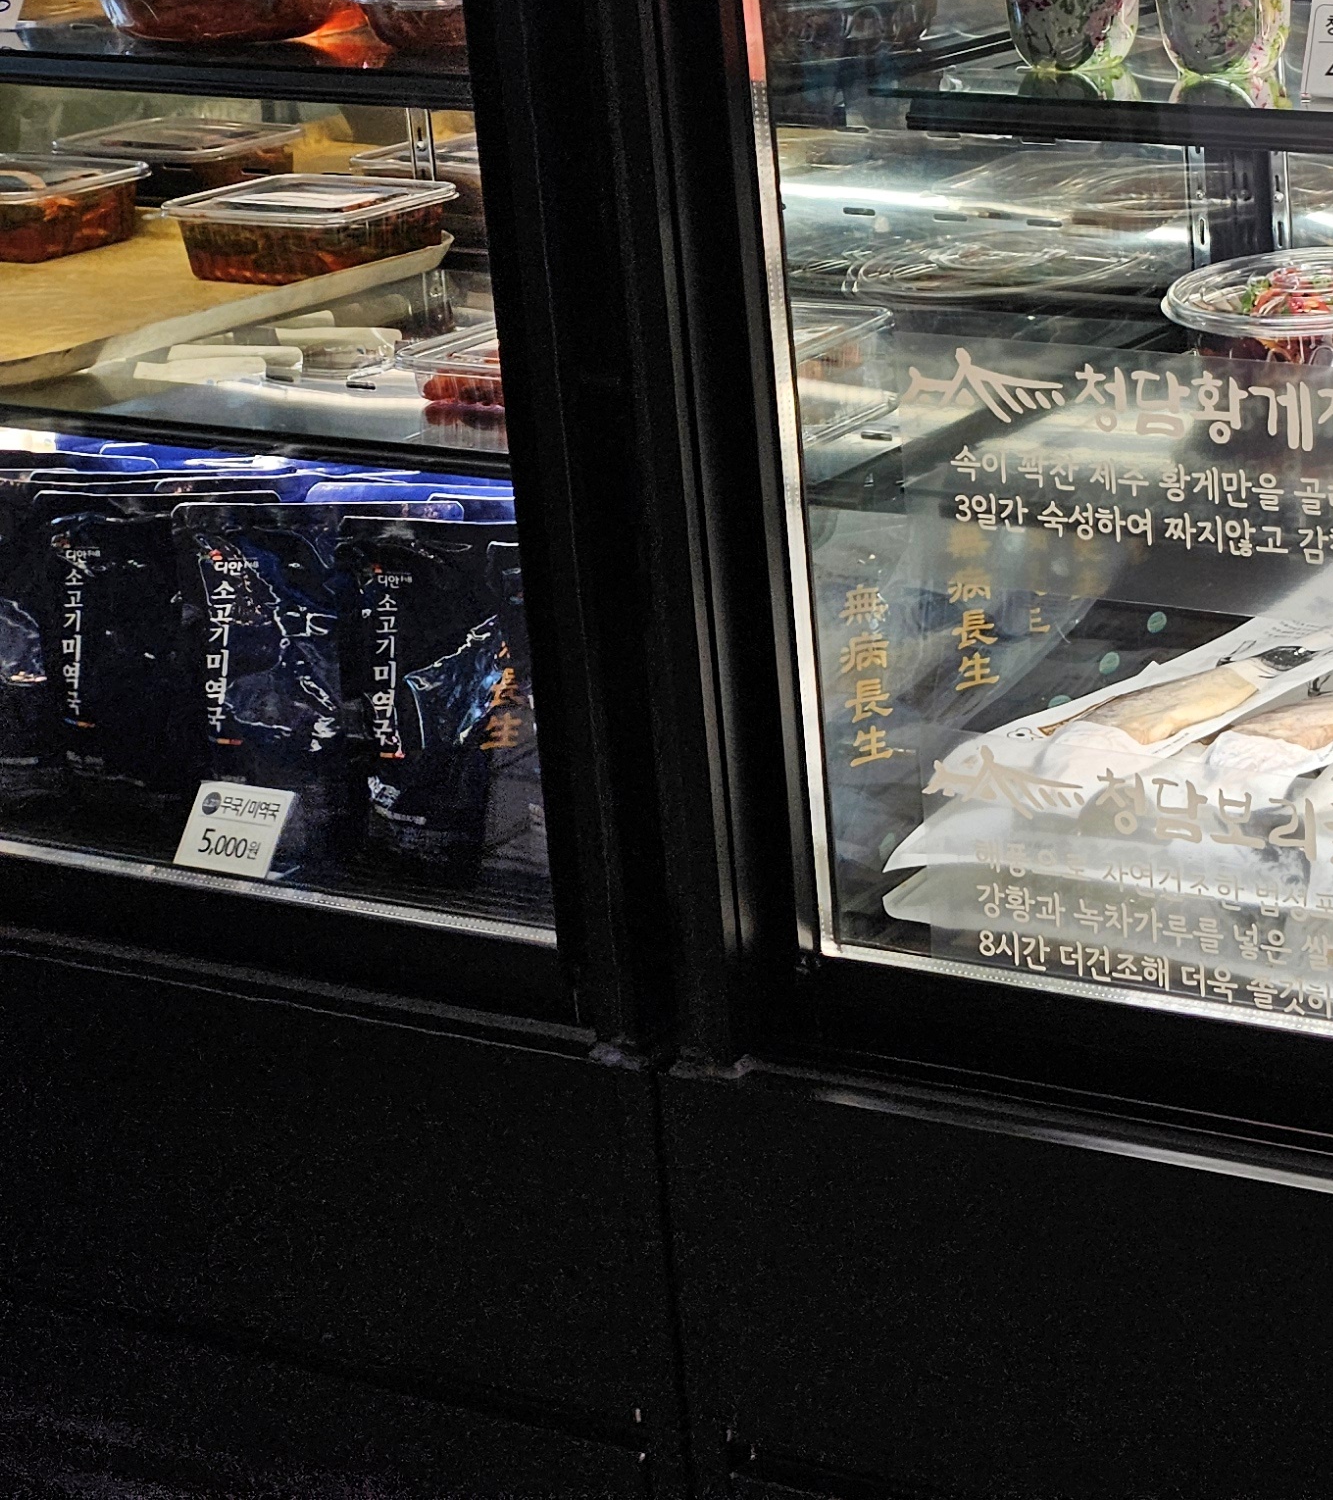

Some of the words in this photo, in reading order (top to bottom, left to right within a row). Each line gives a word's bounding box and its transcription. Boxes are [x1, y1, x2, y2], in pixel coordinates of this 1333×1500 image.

[950, 445, 1007, 484] 속이
[1089, 460, 1149, 497] 제주
[1159, 463, 1285, 510] 황게만을
[955, 494, 1028, 533] 3일간
[1037, 501, 1153, 546] 숙성하여
[1164, 512, 1289, 557] 짜지않고
[214, 560, 243, 575] 디안
[61, 568, 84, 716] 소고기미역국
[204, 580, 237, 733] 소고기미역국
[371, 593, 399, 746] 소고기미역국
[838, 584, 896, 768] 無病長生
[197, 828, 261, 860] 5,000원
[976, 882, 1066, 928] 강황과
[1073, 896, 1225, 953] 녹차가루를
[1233, 923, 1292, 965] 넣은
[977, 929, 1050, 971] 8시간
[1059, 946, 1170, 991] 더건조해
[1180, 963, 1239, 1001] 더욱
